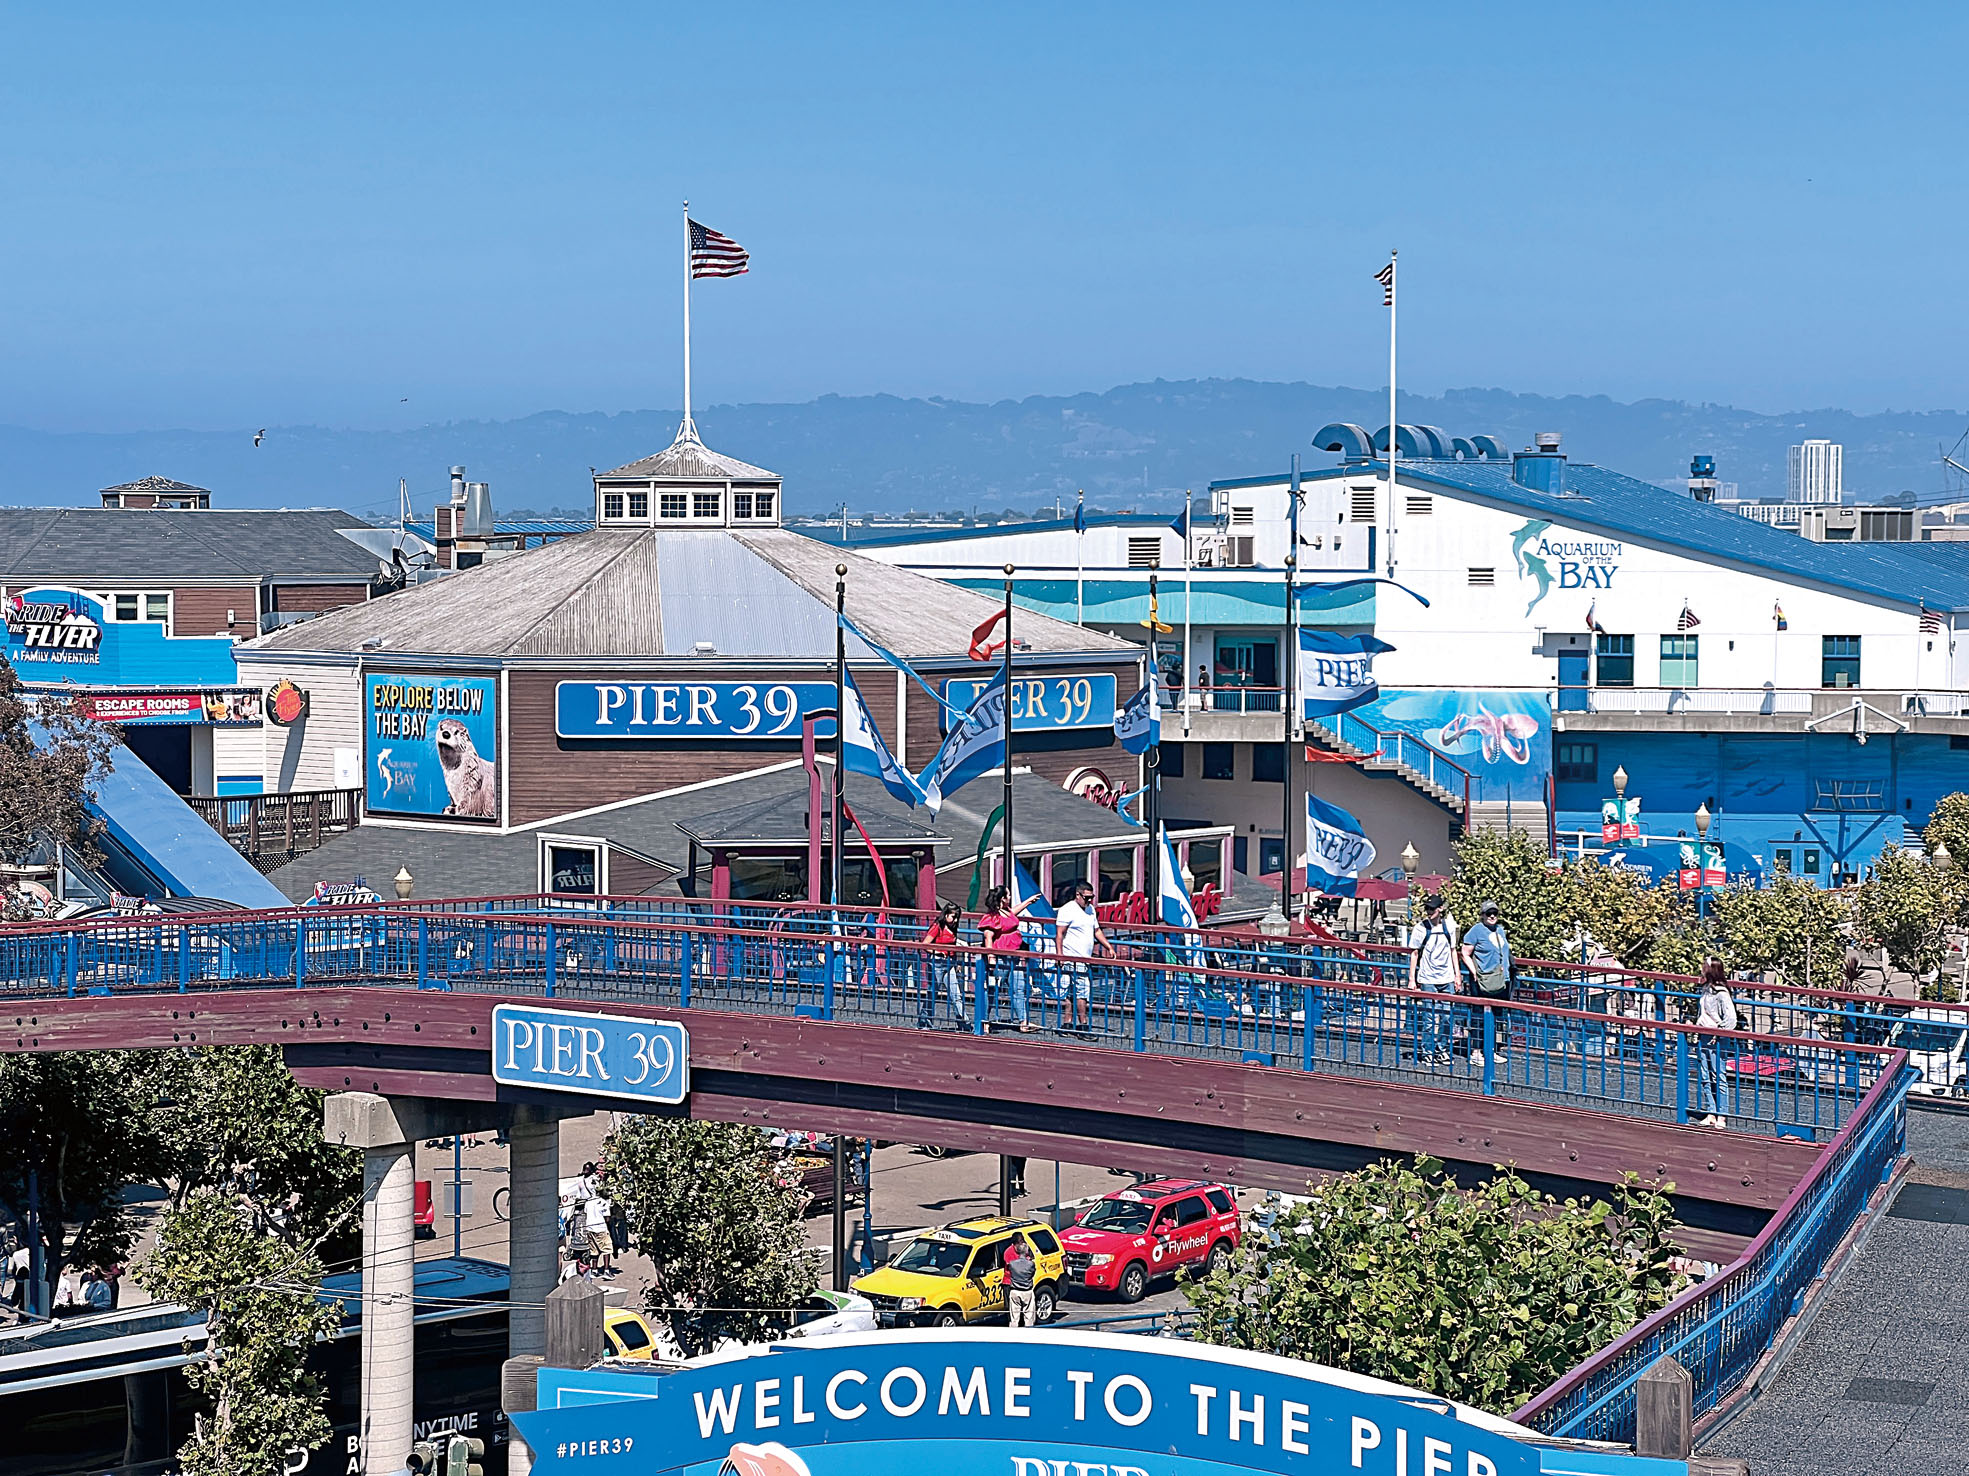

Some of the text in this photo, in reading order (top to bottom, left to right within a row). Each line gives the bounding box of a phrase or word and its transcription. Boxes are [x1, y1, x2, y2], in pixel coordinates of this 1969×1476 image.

[1536, 538, 1622, 560] AQUARIUM
[1582, 557, 1612, 565] OF THE
[1558, 562, 1619, 588] BAY
[20, 604, 67, 623] RIDE
[9, 624, 26, 633] THE
[25, 625, 98, 649] FLYER
[13, 650, 100, 665] A FAMILY ADVENTURE
[95, 698, 190, 711] ESCAPE ROOMS
[374, 685, 484, 711] EXPLORE BELOW
[595, 685, 798, 734] PIER 39
[1054, 678, 1092, 725] 39
[374, 713, 428, 738] THE BAY
[1191, 882, 1222, 923] afe
[502, 1018, 674, 1088] PIER 39
[938, 1232, 951, 1240] TAXI
[1168, 1233, 1209, 1256] Flywheel
[693, 1366, 1031, 1438] WELCOME
[1067, 1370, 1153, 1427] TO
[1190, 1383, 1309, 1455] THE
[413, 1412, 479, 1441] NYTIME
[556, 1437, 634, 1458] #PIER39
